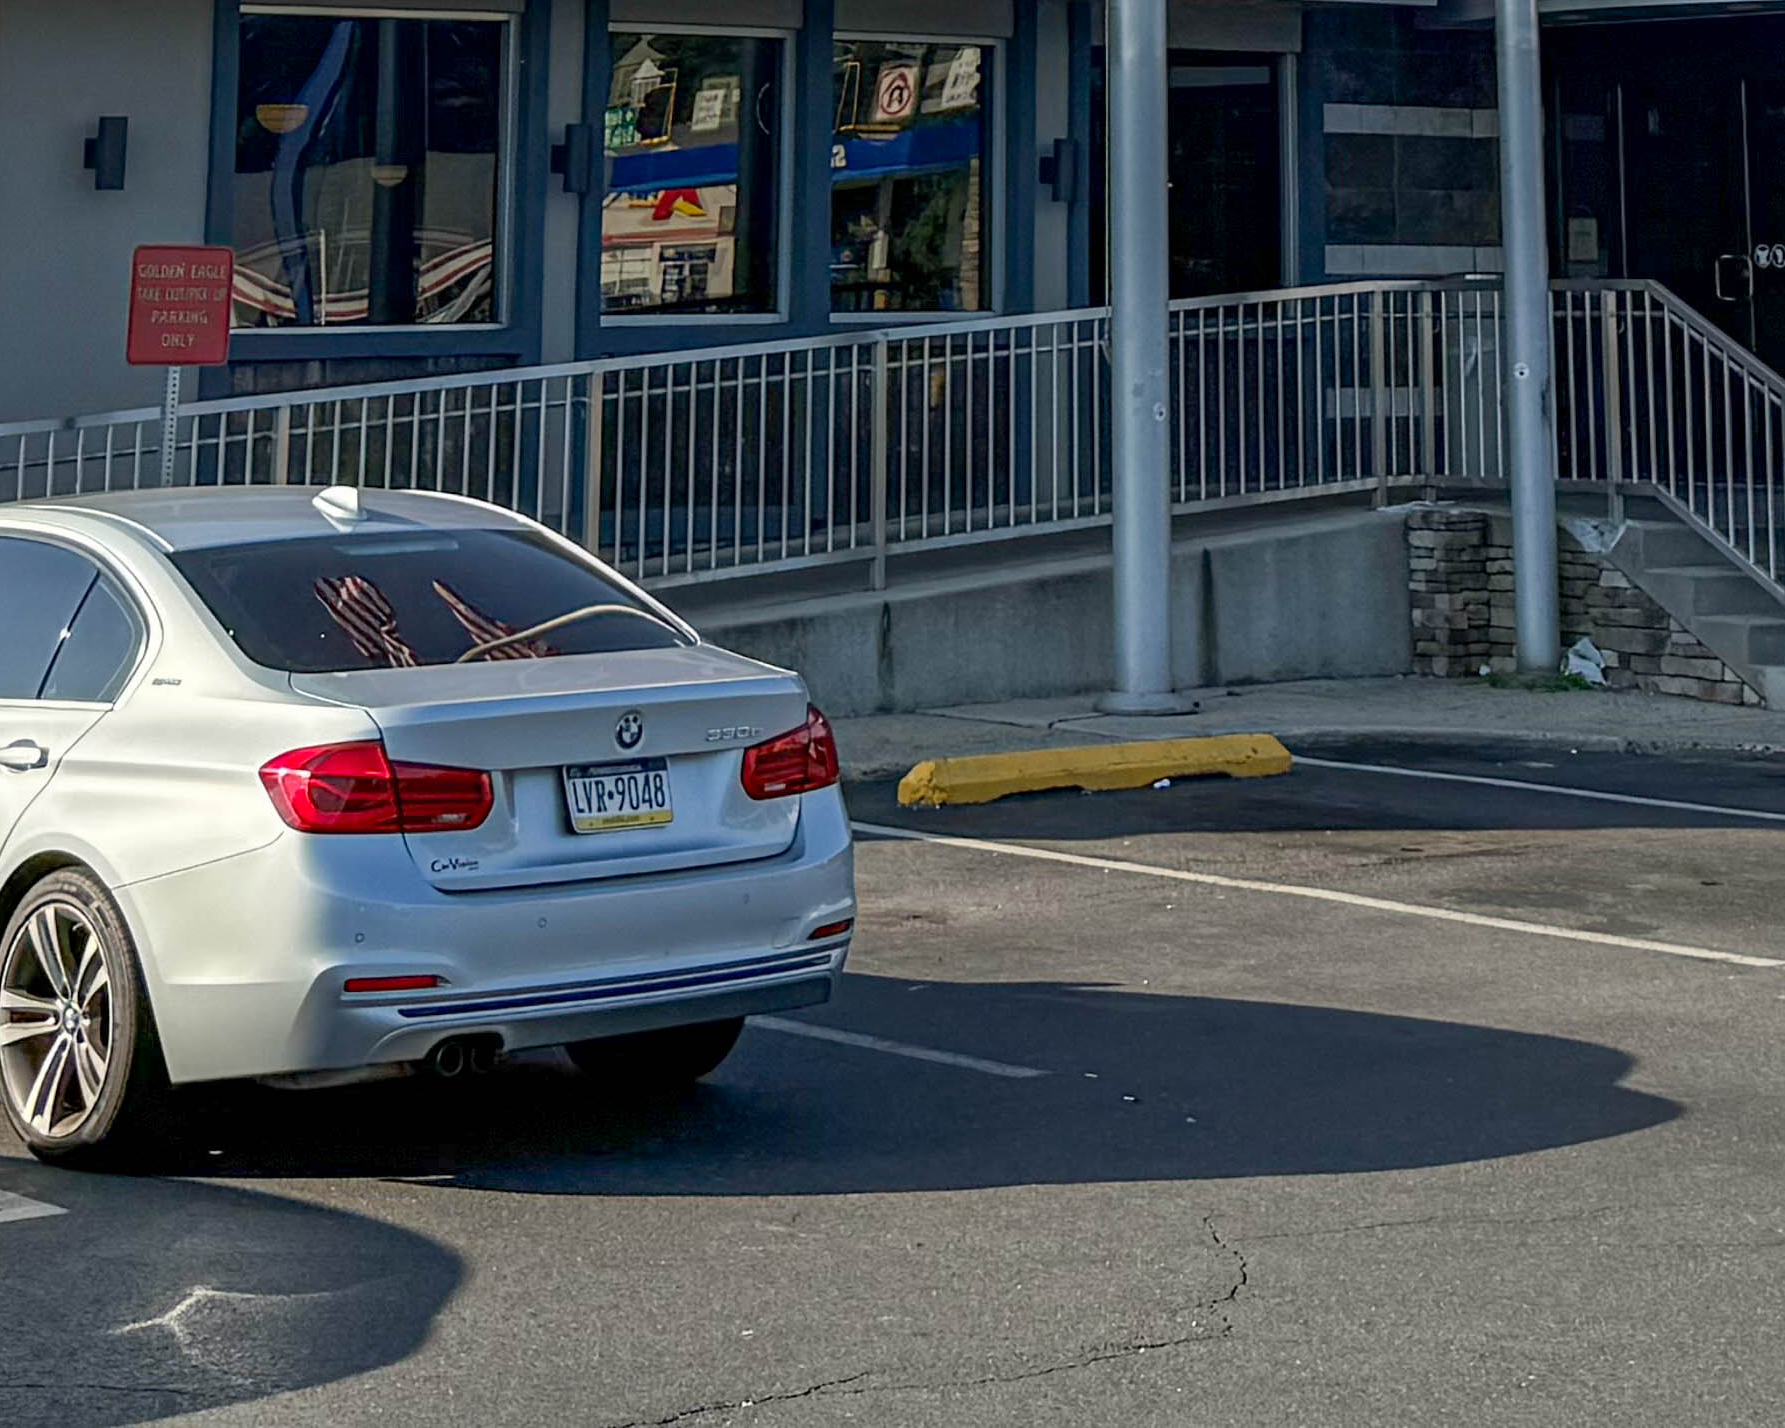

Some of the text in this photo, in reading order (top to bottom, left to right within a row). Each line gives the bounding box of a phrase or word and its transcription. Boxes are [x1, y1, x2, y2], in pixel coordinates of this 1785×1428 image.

[138, 264, 226, 280] GOLDEN EAGLE
[151, 310, 208, 324] PARKING
[162, 334, 195, 347] ONLY
